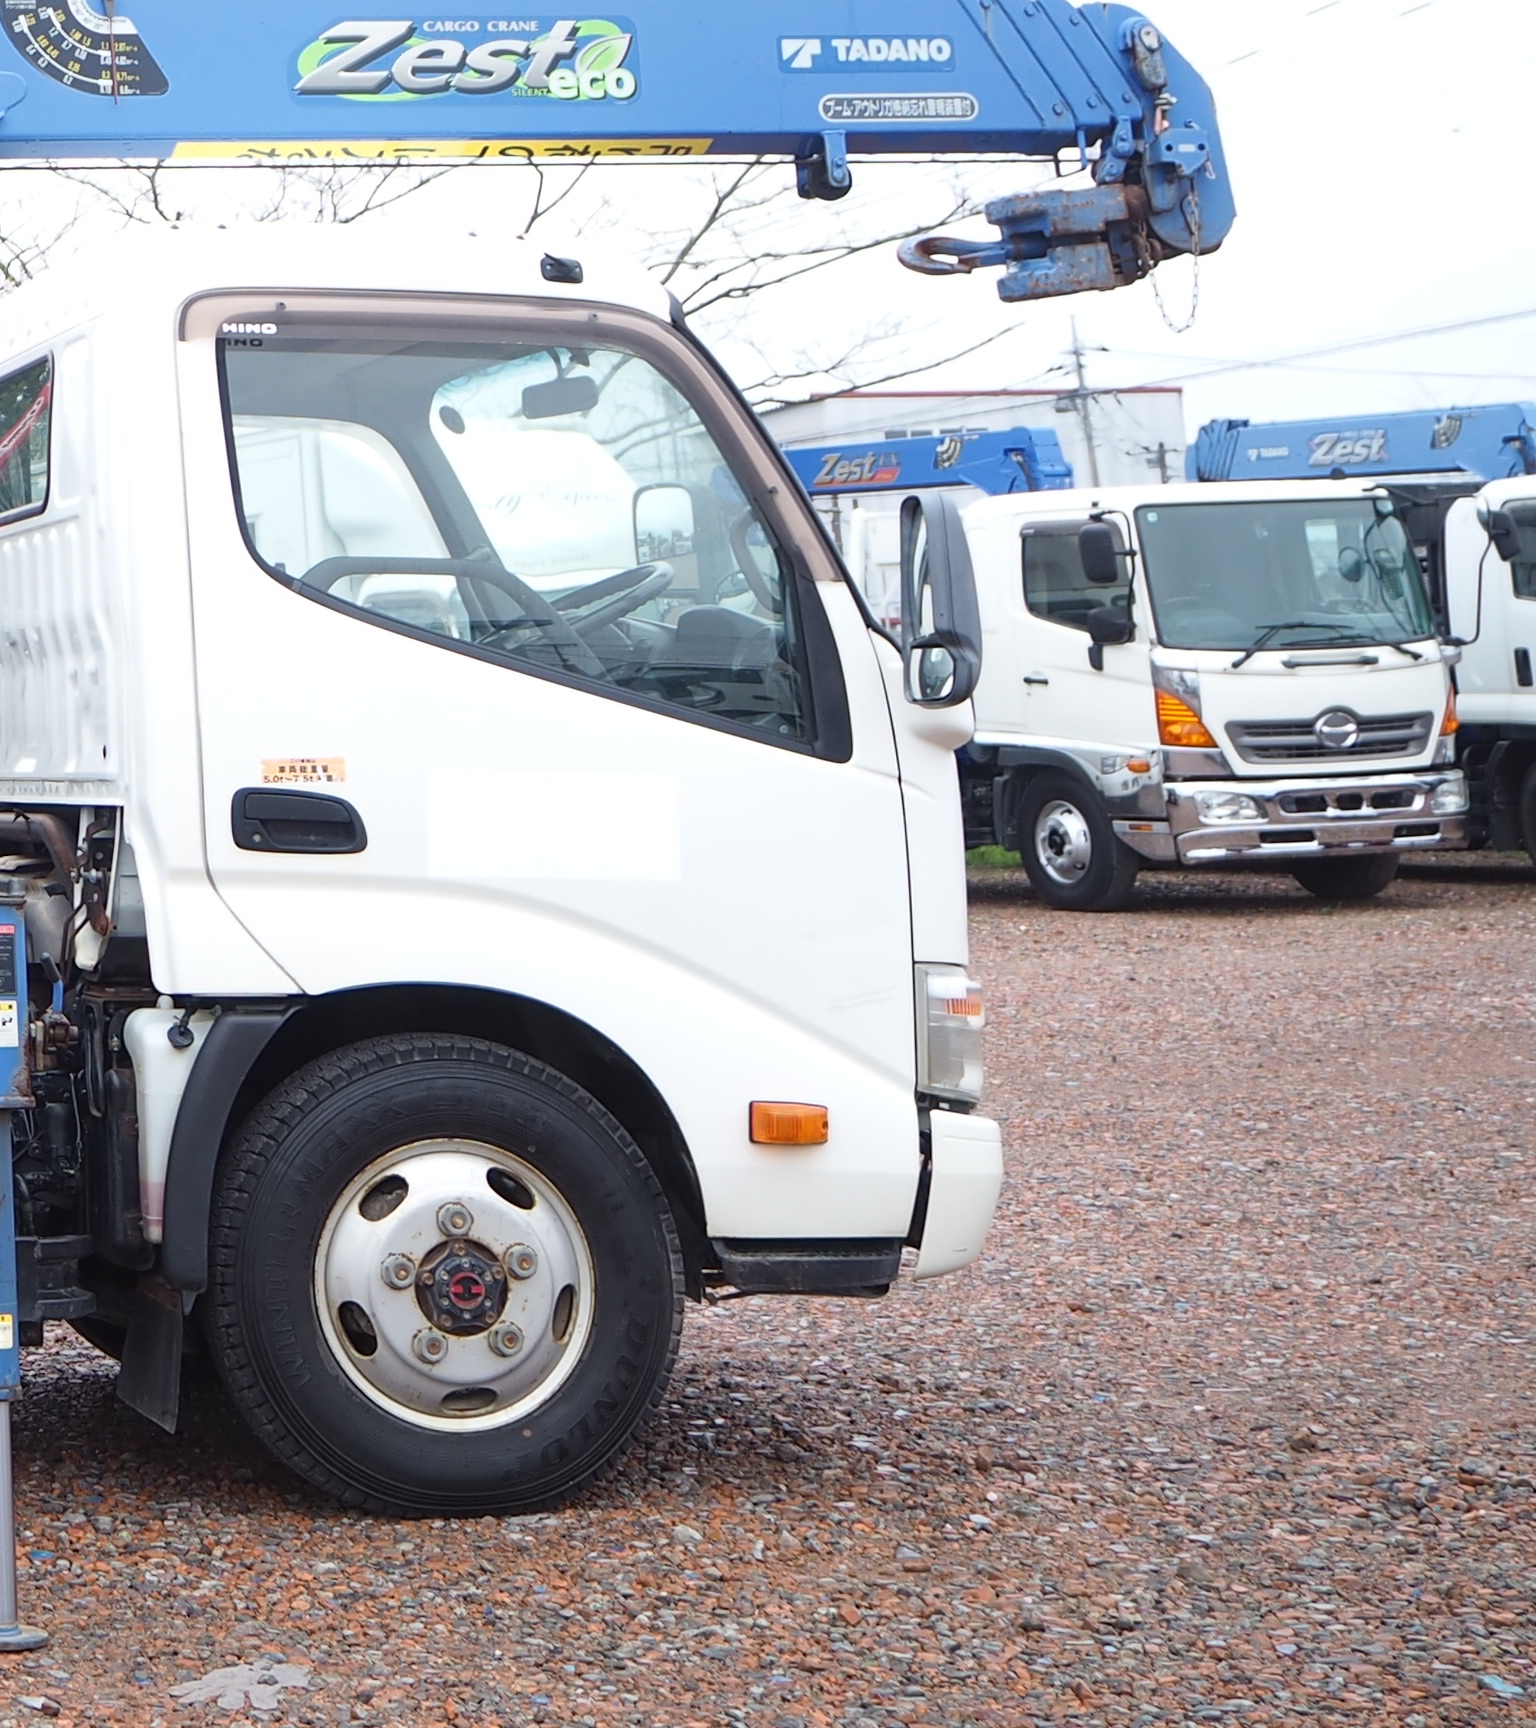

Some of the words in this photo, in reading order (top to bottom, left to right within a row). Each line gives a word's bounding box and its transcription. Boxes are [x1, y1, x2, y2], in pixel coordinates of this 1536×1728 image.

[422, 20, 480, 33] CARGO
[486, 20, 540, 33] CRANE
[291, 19, 578, 96] Zest
[548, 67, 638, 100] eco
[830, 37, 952, 63] TADANO
[221, 322, 278, 335] HINO
[1308, 428, 1386, 467] Zest
[812, 451, 876, 485] Zest
